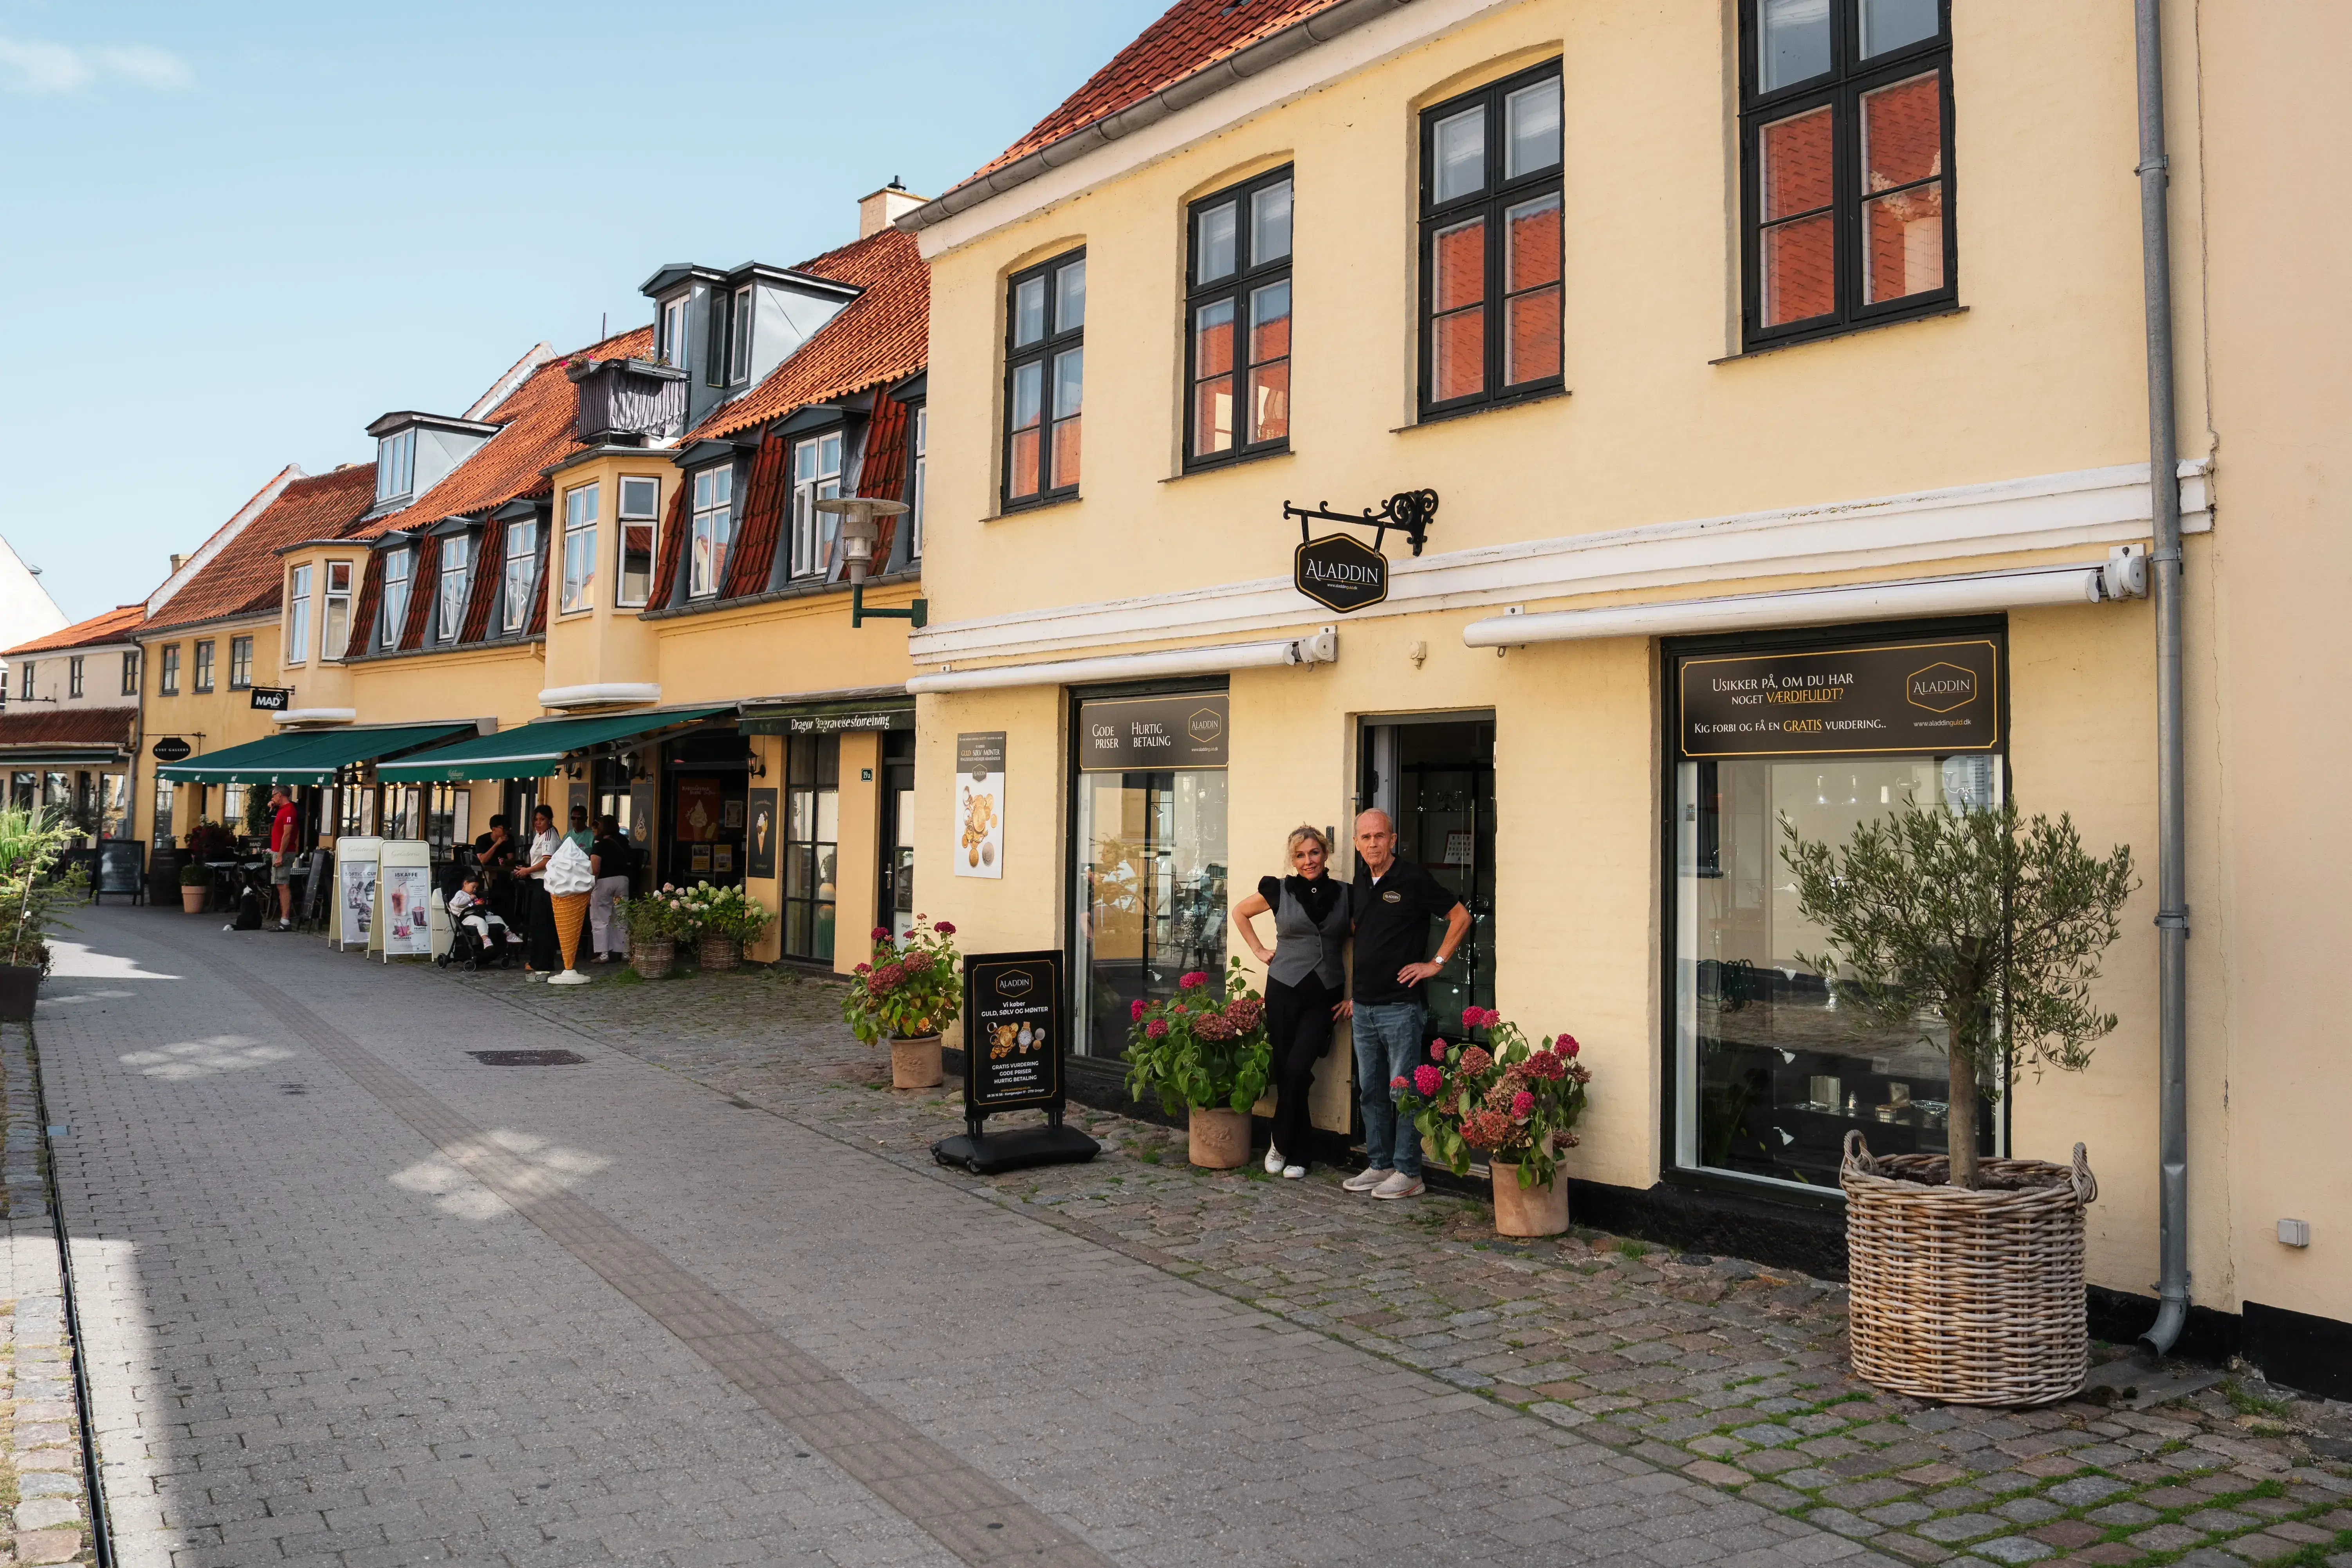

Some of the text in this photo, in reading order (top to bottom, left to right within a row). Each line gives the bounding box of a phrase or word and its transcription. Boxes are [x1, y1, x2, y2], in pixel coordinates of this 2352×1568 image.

[1305, 558, 1378, 583] ALADDIN
[1712, 673, 1854, 691] USIKKER PÅ, OM DU HAR
[1913, 679, 1970, 695] ALADDIN
[256, 696, 280, 706] MAD
[1732, 688, 1844, 705] NOGET VÆRDIFULDT?
[791, 719, 813, 733] Dragør
[1092, 724, 1114, 737] GODE
[1132, 722, 1162, 735] HURTIG
[1191, 720, 1218, 730] ALADDIN
[1695, 723, 1710, 733] KIG
[1713, 724, 1736, 732] FORBI
[1739, 723, 1752, 731] OG
[1755, 719, 1766, 731] FÅ
[1769, 722, 1780, 731] EN
[1783, 720, 1822, 732] GRATIS
[1095, 738, 1119, 749] PRISER
[1133, 736, 1171, 747] BETALING
[999, 979, 1030, 989] ALADDIN
